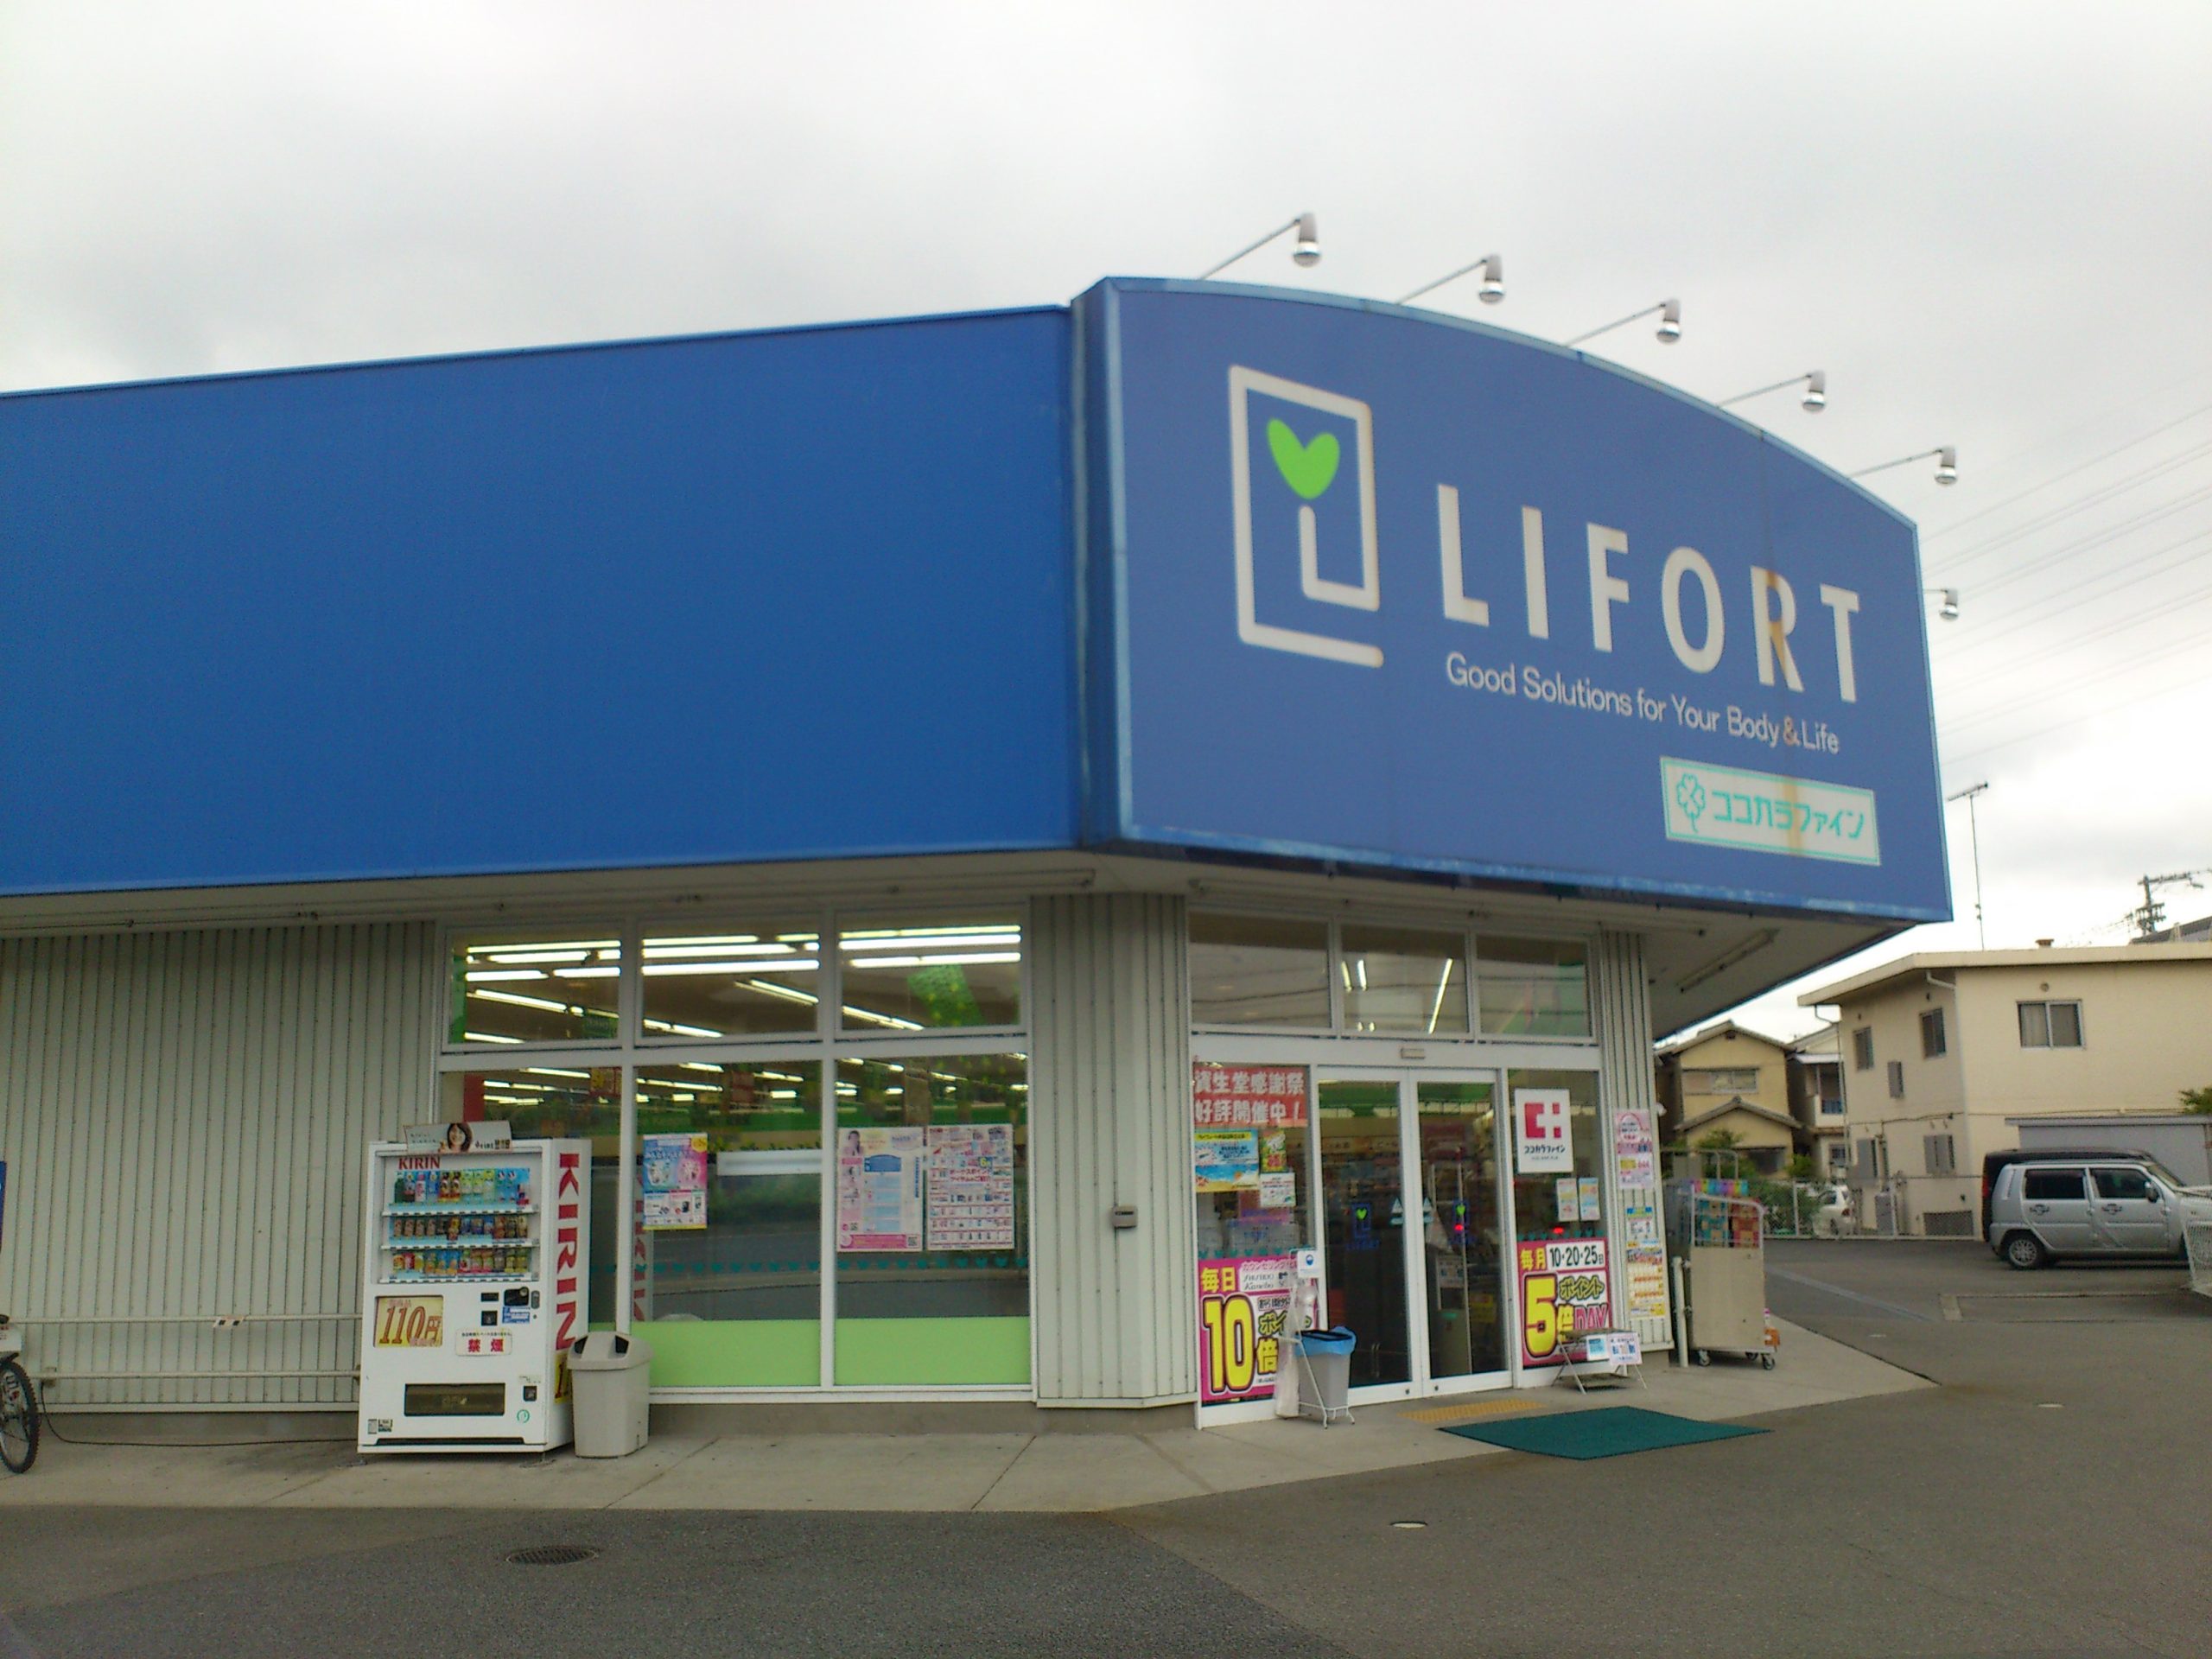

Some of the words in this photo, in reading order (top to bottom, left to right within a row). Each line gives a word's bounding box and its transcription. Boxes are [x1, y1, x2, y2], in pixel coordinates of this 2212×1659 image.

[1437, 483, 1859, 703] LIFORT
[1446, 652, 1516, 696] Good
[1522, 665, 1632, 716] Solutions
[1637, 689, 1667, 722] for
[1672, 695, 1720, 732] Your
[1712, 790, 1866, 839] ココカラファイン
[398, 1156, 441, 1170] KIRIN
[555, 1154, 580, 1351] KIRIN
[1520, 1248, 1547, 1270] 毎月
[1202, 1267, 1236, 1293] 毎日
[1559, 1275, 1605, 1300] ポイント
[378, 1306, 442, 1344] 110円
[1525, 1274, 1558, 1358] 5
[468, 1338, 504, 1352] 禁煙
[1203, 1294, 1255, 1393] 10
